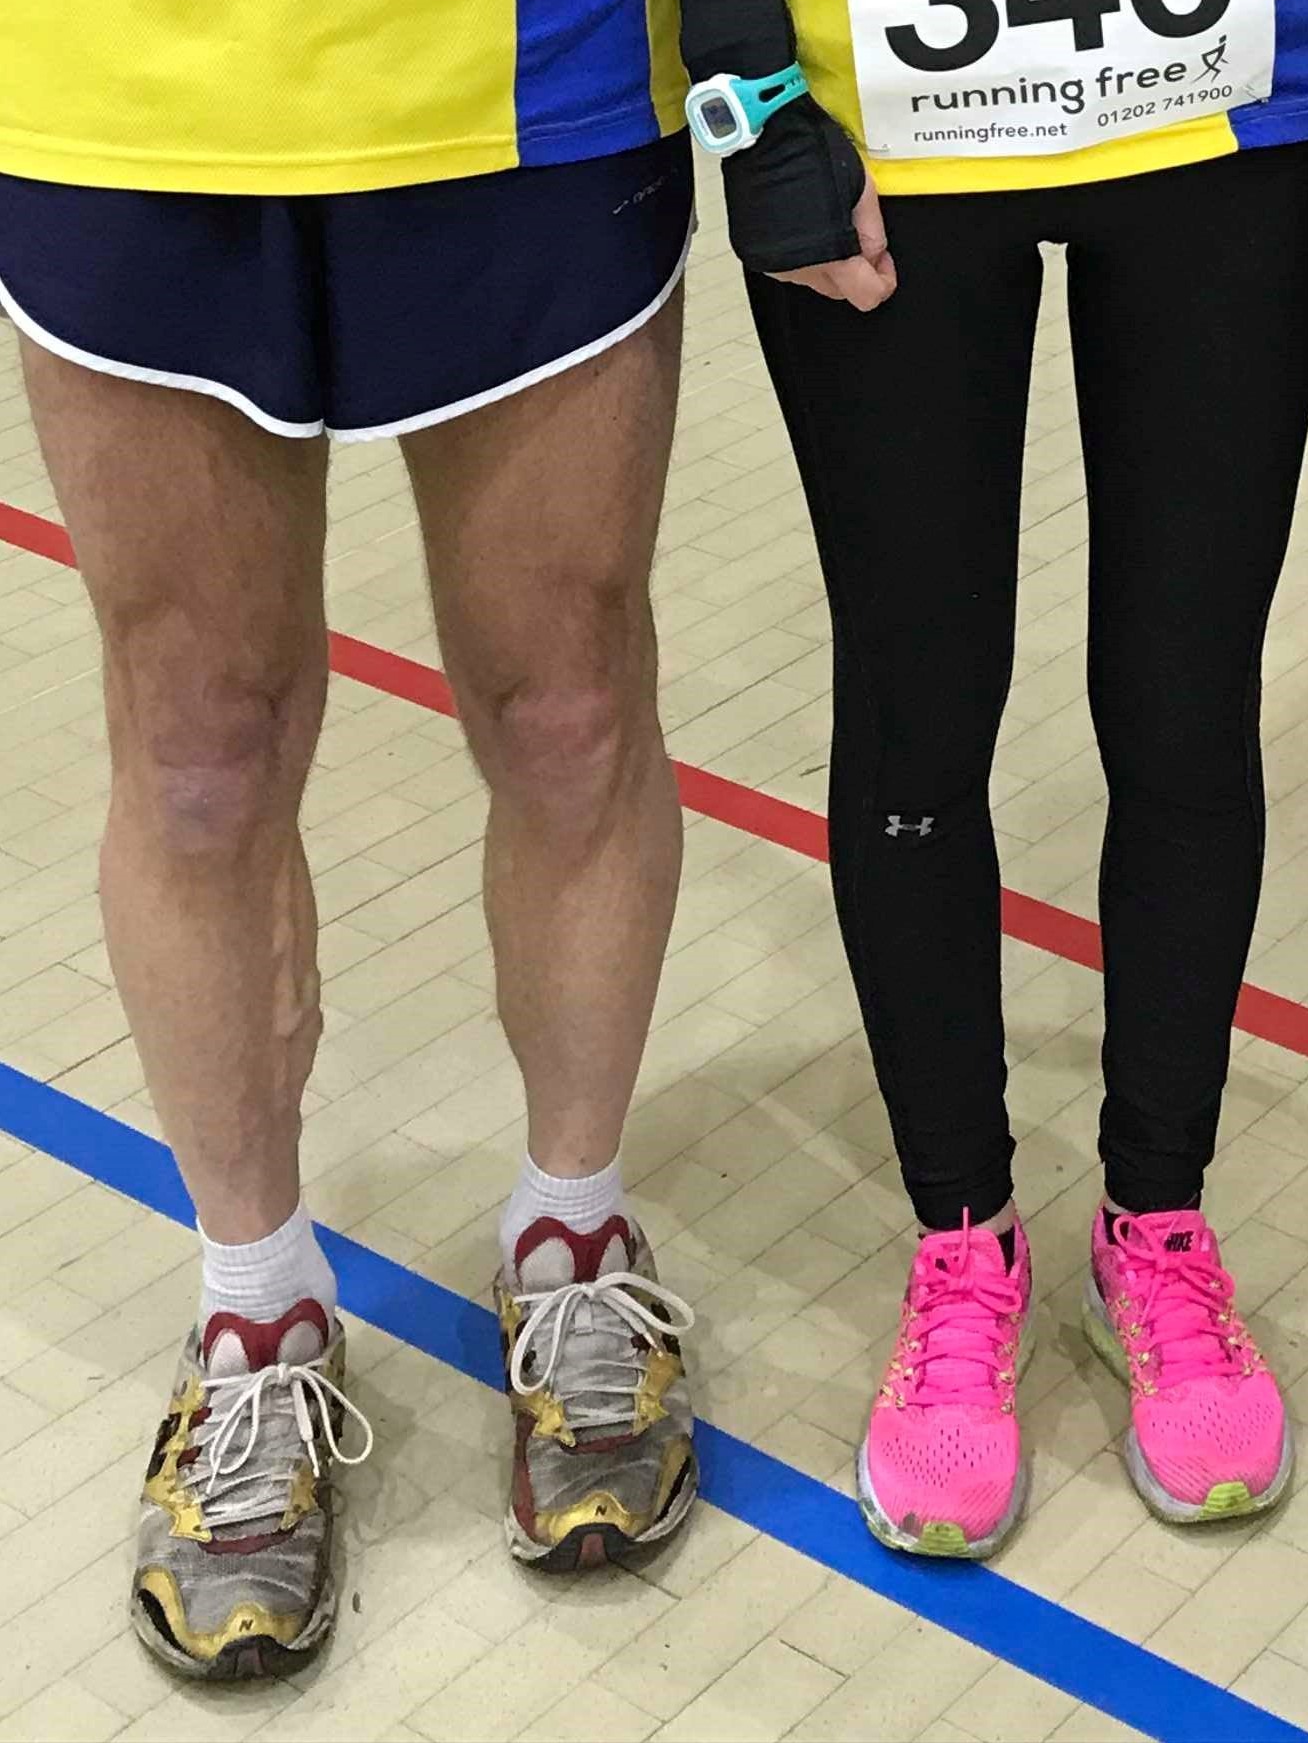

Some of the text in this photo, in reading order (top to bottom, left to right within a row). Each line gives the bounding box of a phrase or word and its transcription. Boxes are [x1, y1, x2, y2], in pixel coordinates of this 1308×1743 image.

[911, 62, 1187, 115] running free
[913, 85, 1233, 144] runningfree.net 01202 741900
